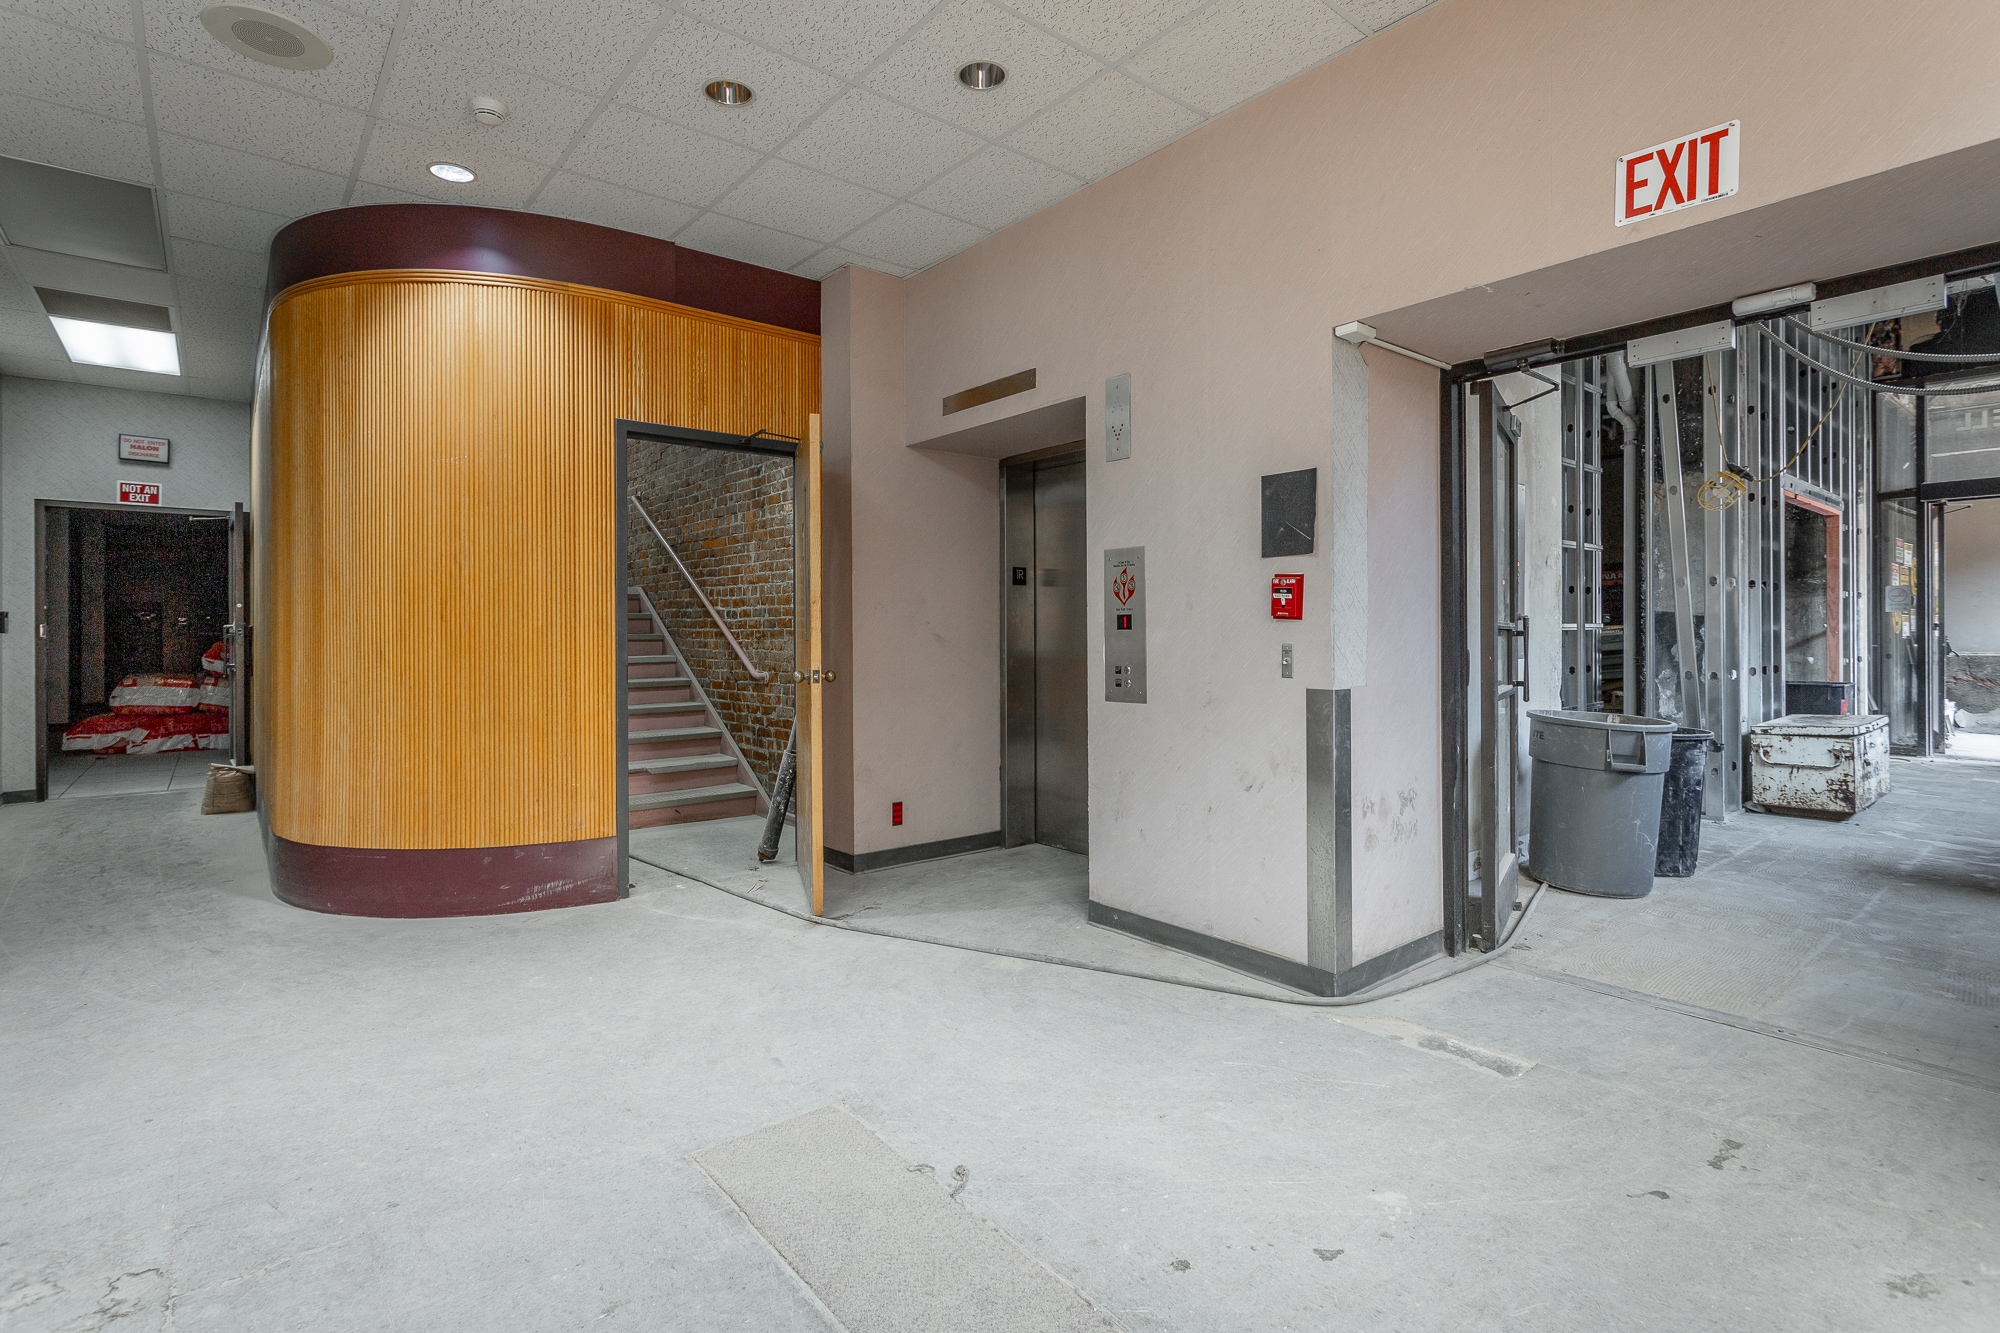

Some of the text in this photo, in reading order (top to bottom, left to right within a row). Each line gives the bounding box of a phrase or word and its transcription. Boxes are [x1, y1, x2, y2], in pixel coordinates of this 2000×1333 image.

[1625, 128, 1729, 219] EXIT
[122, 484, 157, 494] NOT AN
[129, 493, 151, 502] EXIT
[1015, 569, 1024, 580] 1R
